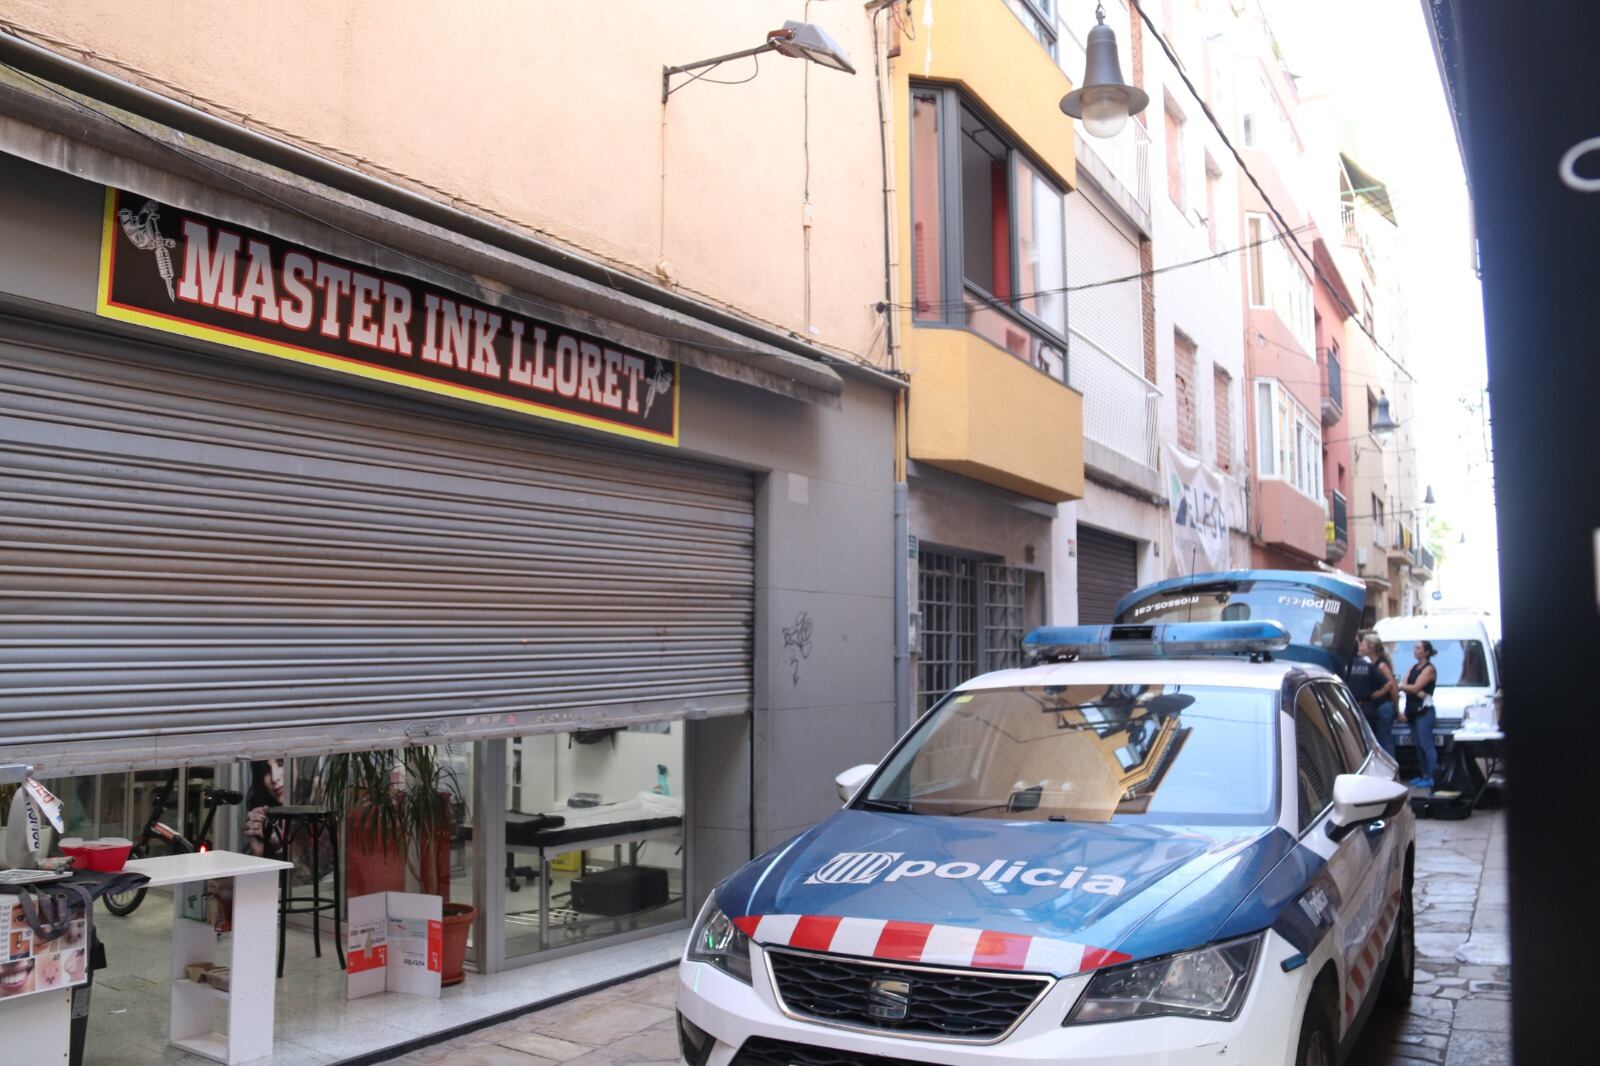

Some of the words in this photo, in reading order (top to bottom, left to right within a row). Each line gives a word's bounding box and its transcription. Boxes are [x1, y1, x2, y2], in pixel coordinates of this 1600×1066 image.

[178, 218, 412, 356] MASTER
[421, 293, 501, 379] INK
[508, 319, 645, 414] LLORET
[884, 858, 1127, 896] policia
